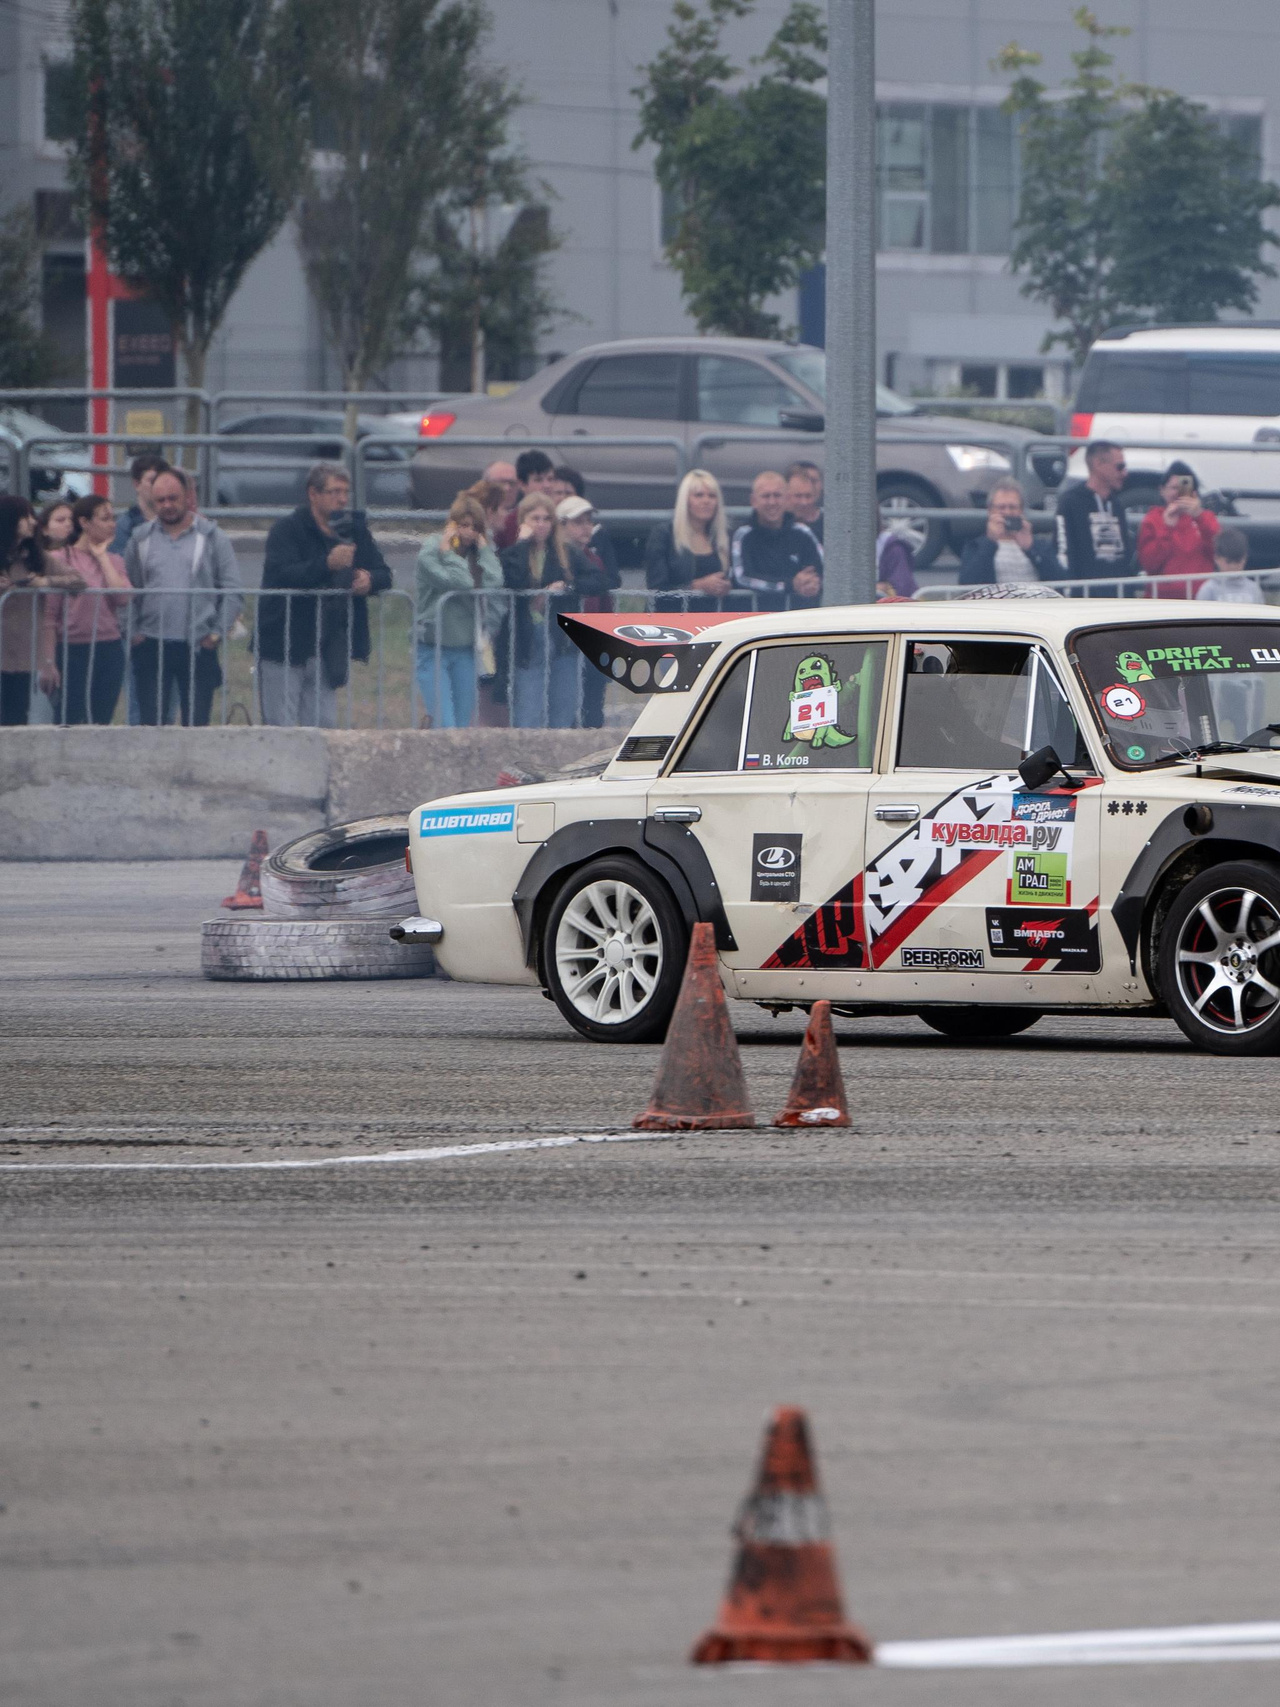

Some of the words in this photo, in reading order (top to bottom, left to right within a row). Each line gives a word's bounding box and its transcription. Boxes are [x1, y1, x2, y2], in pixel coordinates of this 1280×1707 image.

[1146, 645, 1222, 662] DRIFT
[1113, 697, 1134, 708] 21
[798, 701, 825, 721] 21
[762, 754, 773, 766] В.
[776, 754, 809, 766] Котов
[1015, 801, 1051, 816] ДОРОГА
[1035, 808, 1070, 823] ДРИФТ
[422, 812, 512, 830] CLUBTURBO
[931, 822, 1062, 851] кувалда.ру
[1017, 858, 1035, 871] АМ
[1020, 873, 1048, 888] ГРАД
[1013, 929, 1065, 939] ВМПАВТО
[903, 949, 982, 967] PEERFORM
